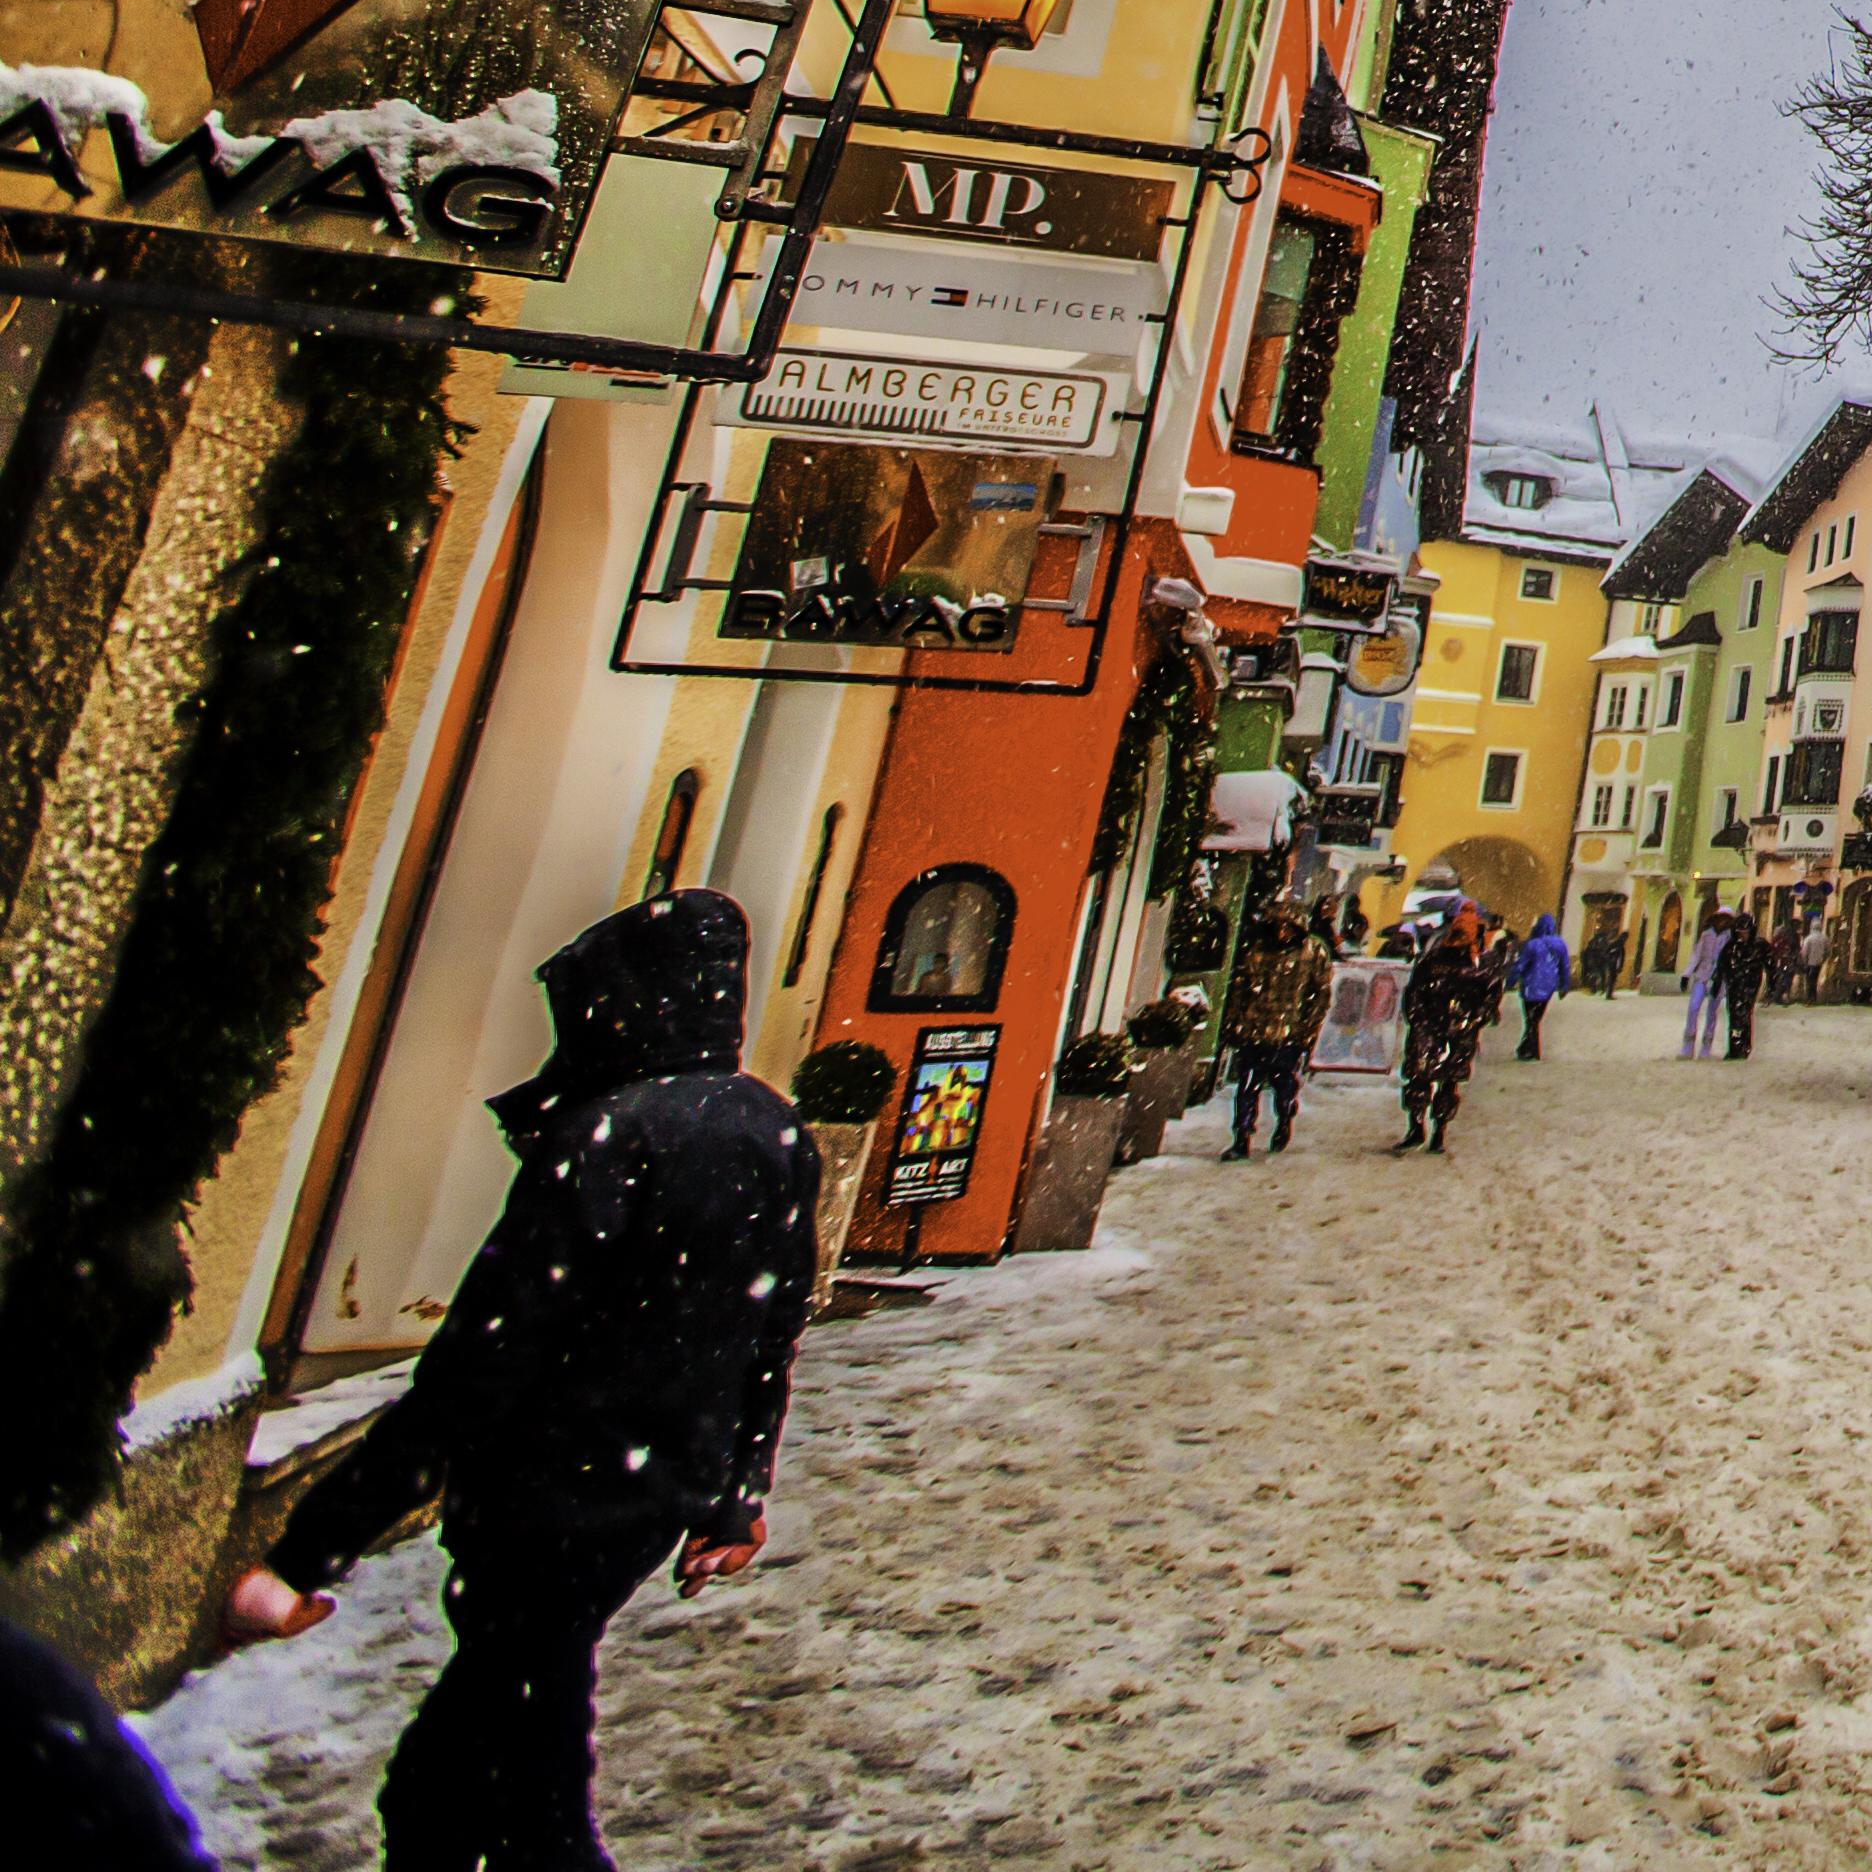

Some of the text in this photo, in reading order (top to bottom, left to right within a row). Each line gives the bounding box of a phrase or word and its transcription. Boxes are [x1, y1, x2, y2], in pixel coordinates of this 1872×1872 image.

[880, 161, 1053, 236] MP.
[801, 274, 1126, 323] OMMY HILFIGER
[778, 359, 1077, 414] ALMBERGER
